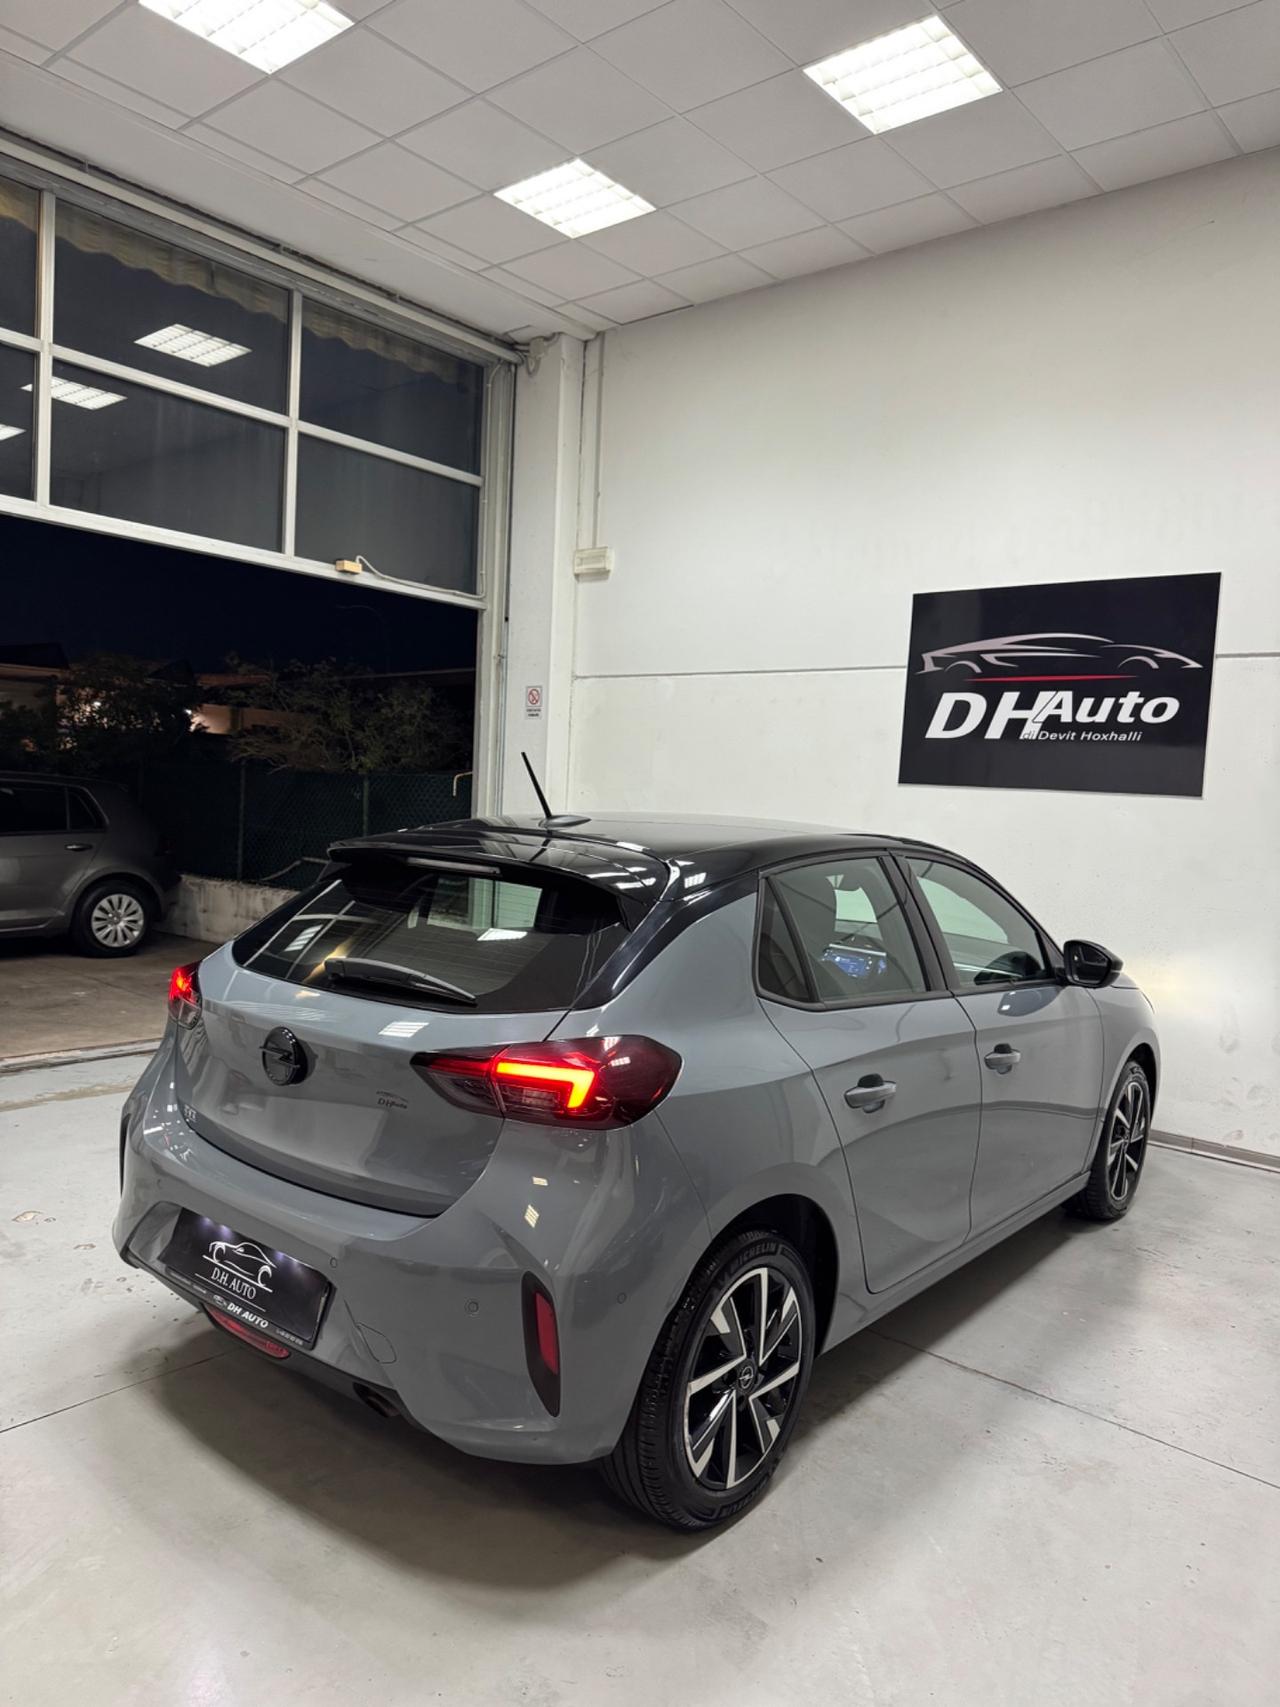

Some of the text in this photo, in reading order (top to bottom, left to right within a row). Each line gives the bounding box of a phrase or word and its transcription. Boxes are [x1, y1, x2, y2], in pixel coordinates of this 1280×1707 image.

[1038, 730, 1076, 741] Devit
[1080, 730, 1142, 742] Hoxhalli
[211, 1267, 228, 1286] D.H.
[229, 1278, 256, 1299] AUTO
[227, 1303, 268, 1328] DH AUTO
